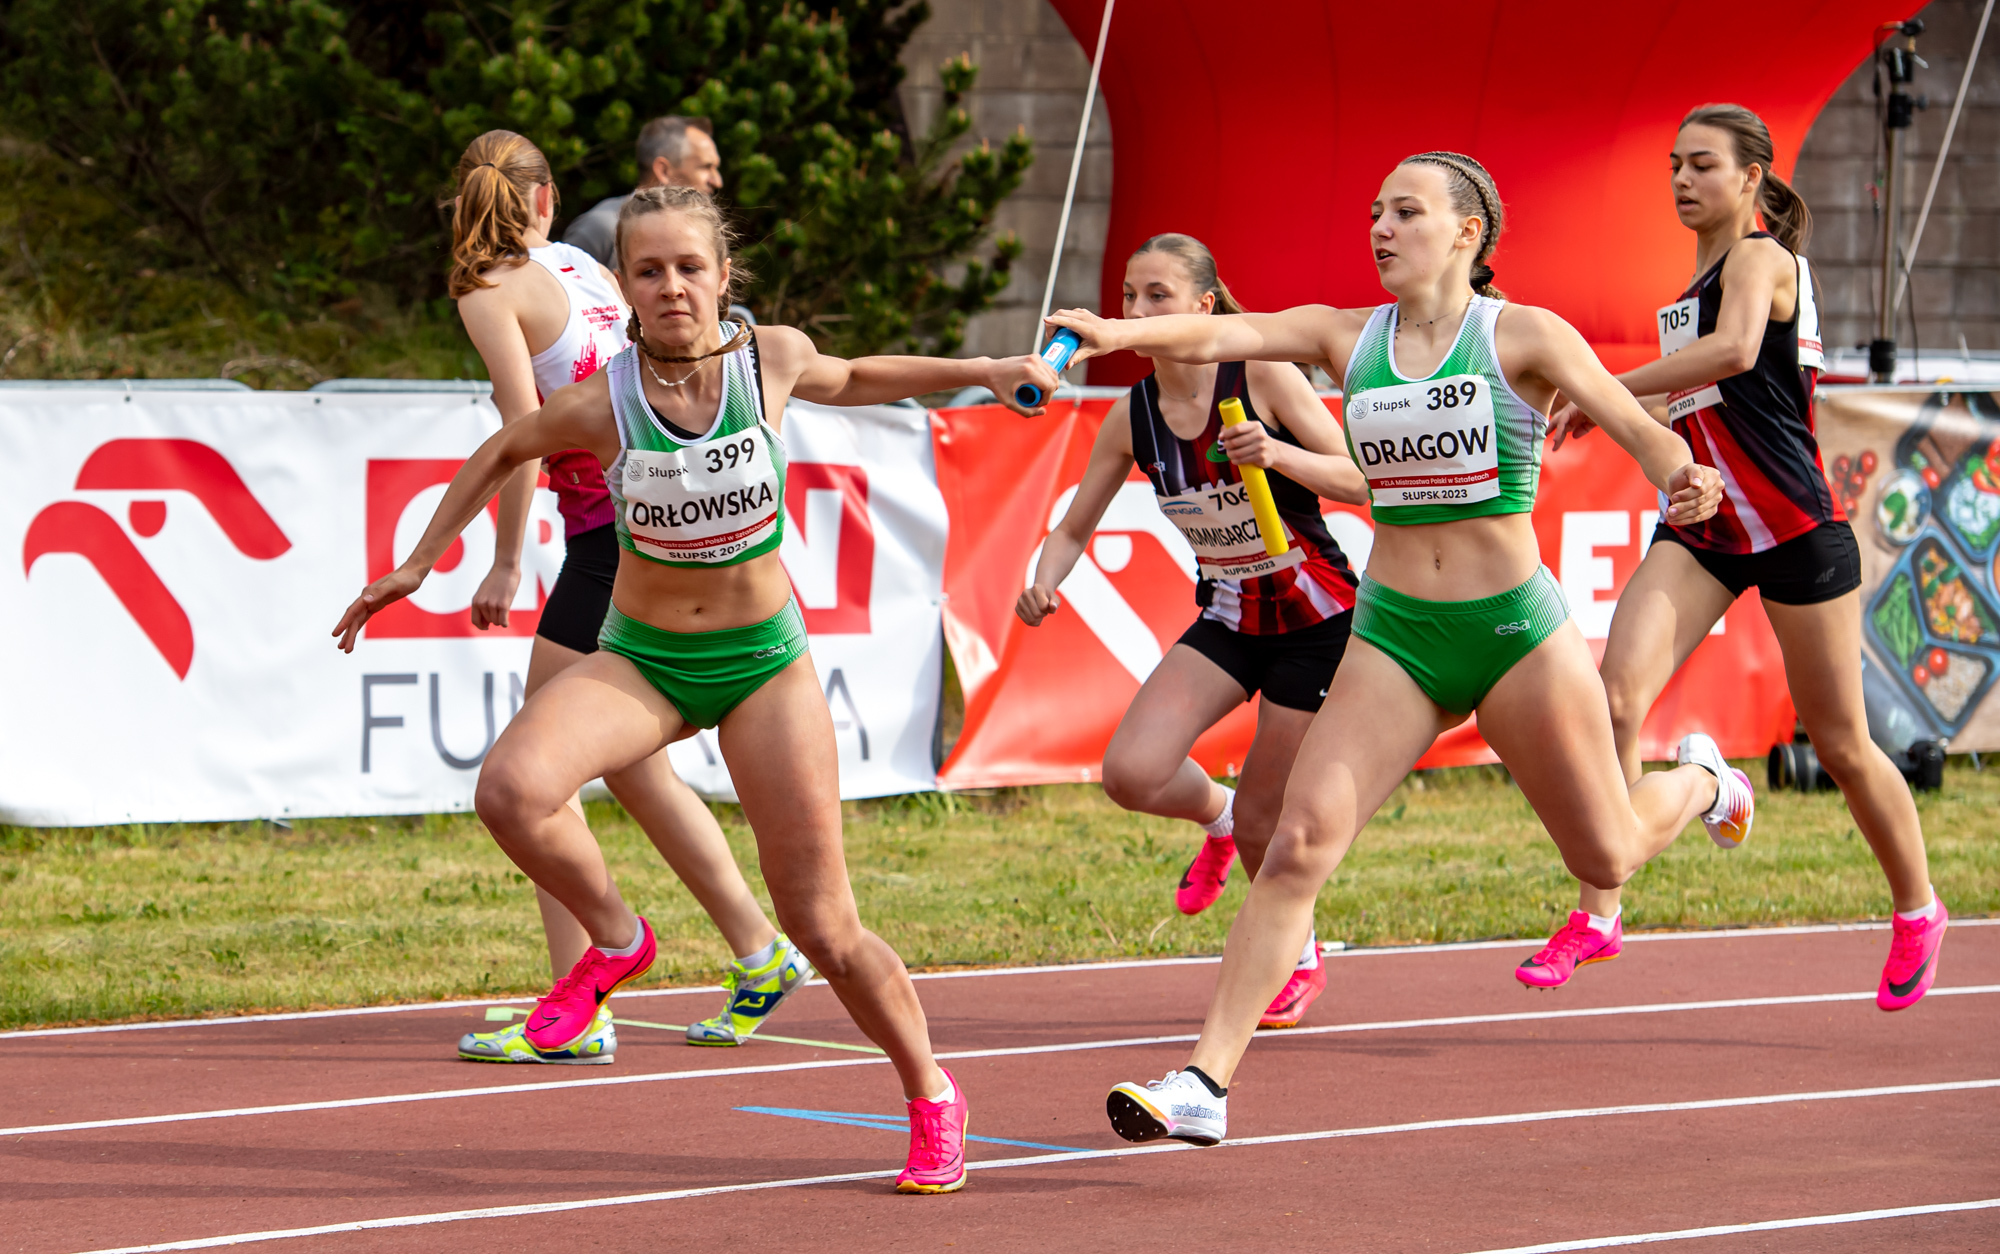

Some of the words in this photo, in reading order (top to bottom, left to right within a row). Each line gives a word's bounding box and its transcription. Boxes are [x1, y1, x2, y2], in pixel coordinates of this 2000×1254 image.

[1661, 306, 1690, 335] 705
[1426, 381, 1477, 411] 389
[1678, 397, 1696, 410] 2023
[1373, 398, 1411, 412] Słupsk
[1359, 425, 1489, 466] DRAGOW
[705, 438, 755, 473] 399
[648, 464, 689, 480] Słupsk
[1395, 478, 1430, 486] Mistrzostwa
[1454, 472, 1489, 483] Sztafetach
[1208, 486, 1250, 511] 706
[1402, 491, 1440, 500] SŁUPSK
[1441, 489, 1468, 499] 2023
[632, 482, 773, 528] ORŁOWSKA
[705, 536, 727, 545] Polski
[669, 550, 717, 560] SŁUPSK
[720, 540, 748, 557] 2023
[1252, 560, 1276, 572] 2023
[1494, 619, 1531, 635] esa
